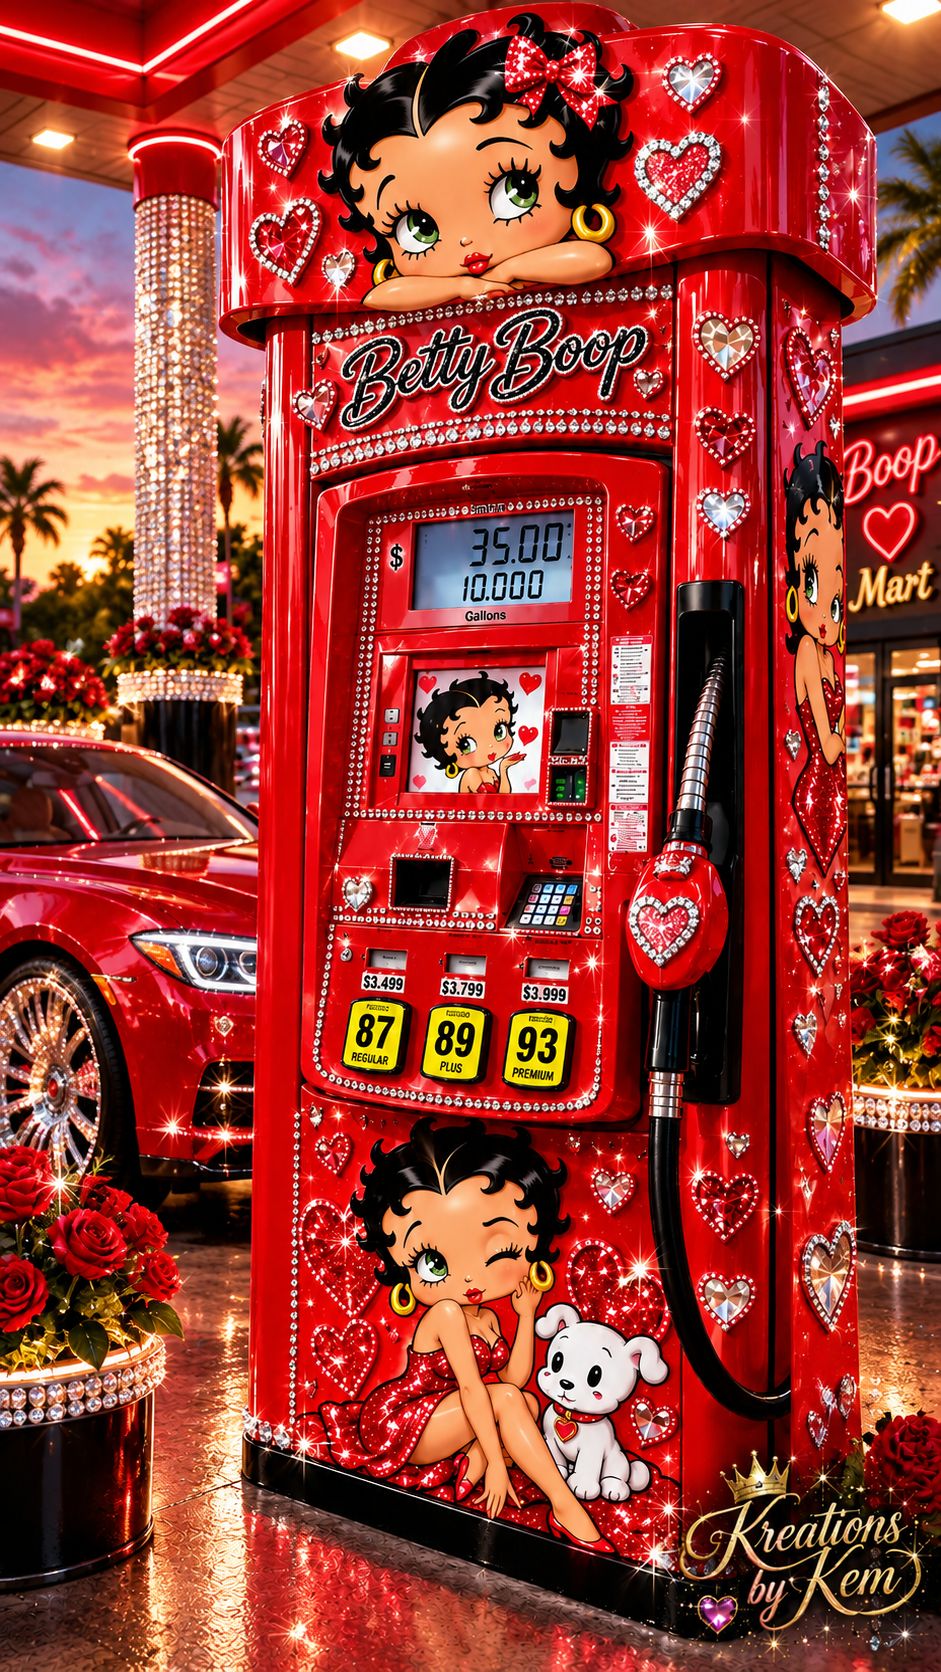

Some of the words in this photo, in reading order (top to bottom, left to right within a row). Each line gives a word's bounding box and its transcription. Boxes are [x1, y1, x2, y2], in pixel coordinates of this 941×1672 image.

[340, 325, 495, 431] Betty
[489, 307, 649, 404] Boop
[843, 434, 941, 504] Boop
[390, 543, 403, 571] $
[470, 522, 564, 567] 35.00
[463, 570, 544, 602] 10.000
[848, 561, 934, 613] Mart
[465, 611, 507, 622] Gallons
[363, 974, 405, 991] $3.499
[441, 981, 484, 998] $3.799
[523, 985, 567, 1002] $3.999
[355, 1013, 395, 1050] 87
[434, 1020, 476, 1059] 89
[516, 1026, 558, 1064] 93
[351, 1052, 389, 1066] REGULAR
[439, 1061, 463, 1074] PLUS
[512, 1067, 555, 1082] PREMIUM
